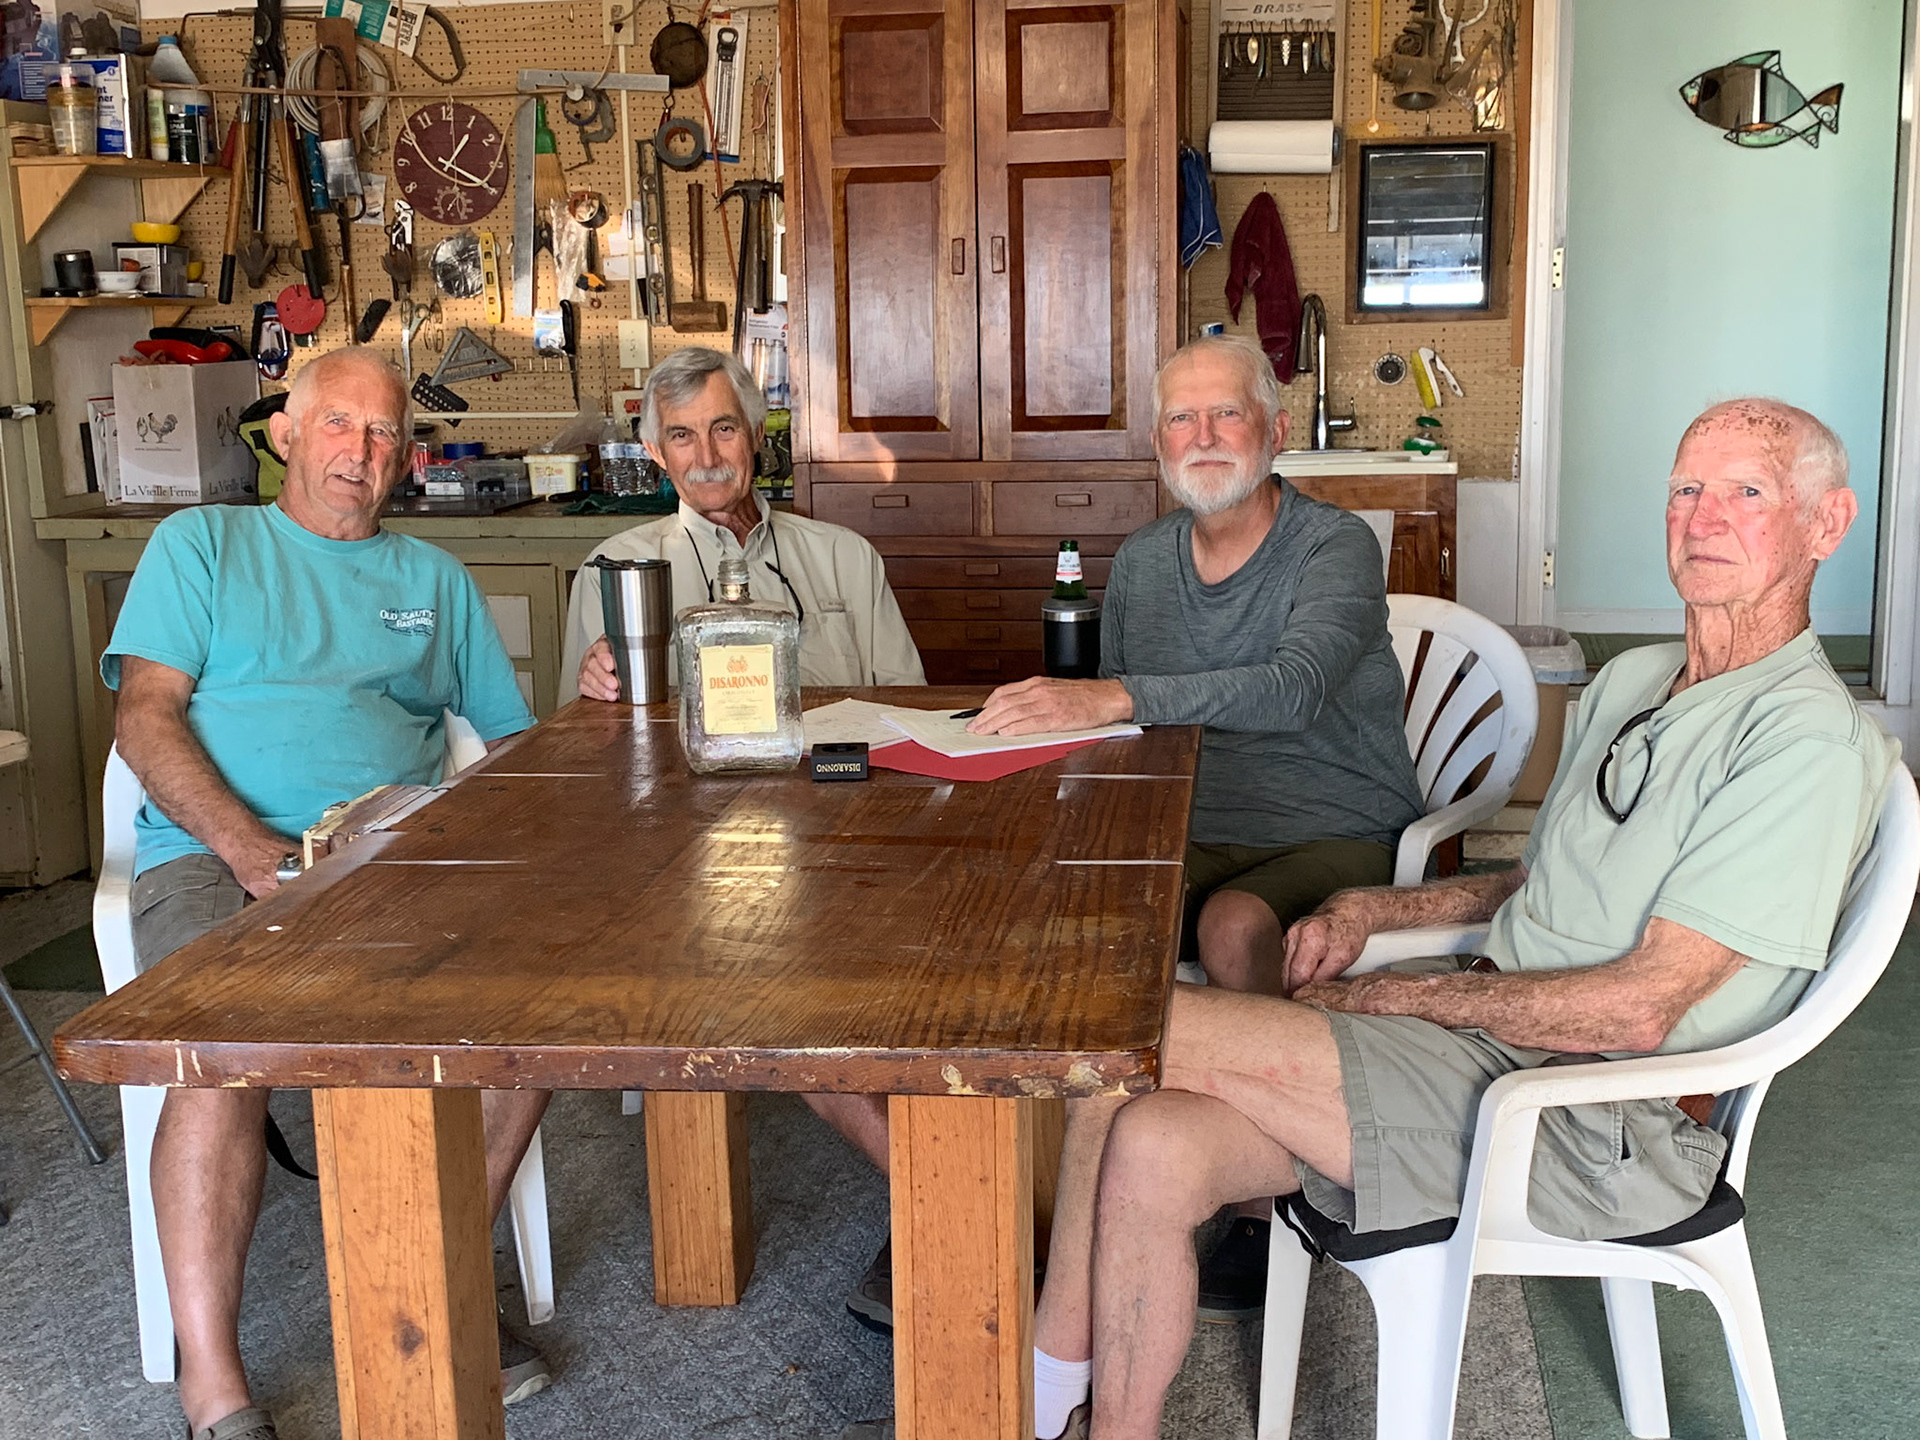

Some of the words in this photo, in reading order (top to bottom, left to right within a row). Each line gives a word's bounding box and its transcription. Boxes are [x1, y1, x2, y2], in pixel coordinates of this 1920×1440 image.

[1253, 3, 1305, 14] BRASS
[417, 111, 433, 130] 11
[467, 115, 476, 129] 1
[482, 133, 495, 147] 2
[397, 158, 410, 167] 9
[405, 181, 417, 194] 8
[125, 485, 137, 496] La
[139, 484, 167, 497] Vieille
[169, 485, 199, 497] Ferme
[380, 609, 397, 620] OLD
[401, 609, 435, 620] SALTY
[709, 674, 768, 689] DISARONNO
[816, 763, 861, 772] DISARONNO
